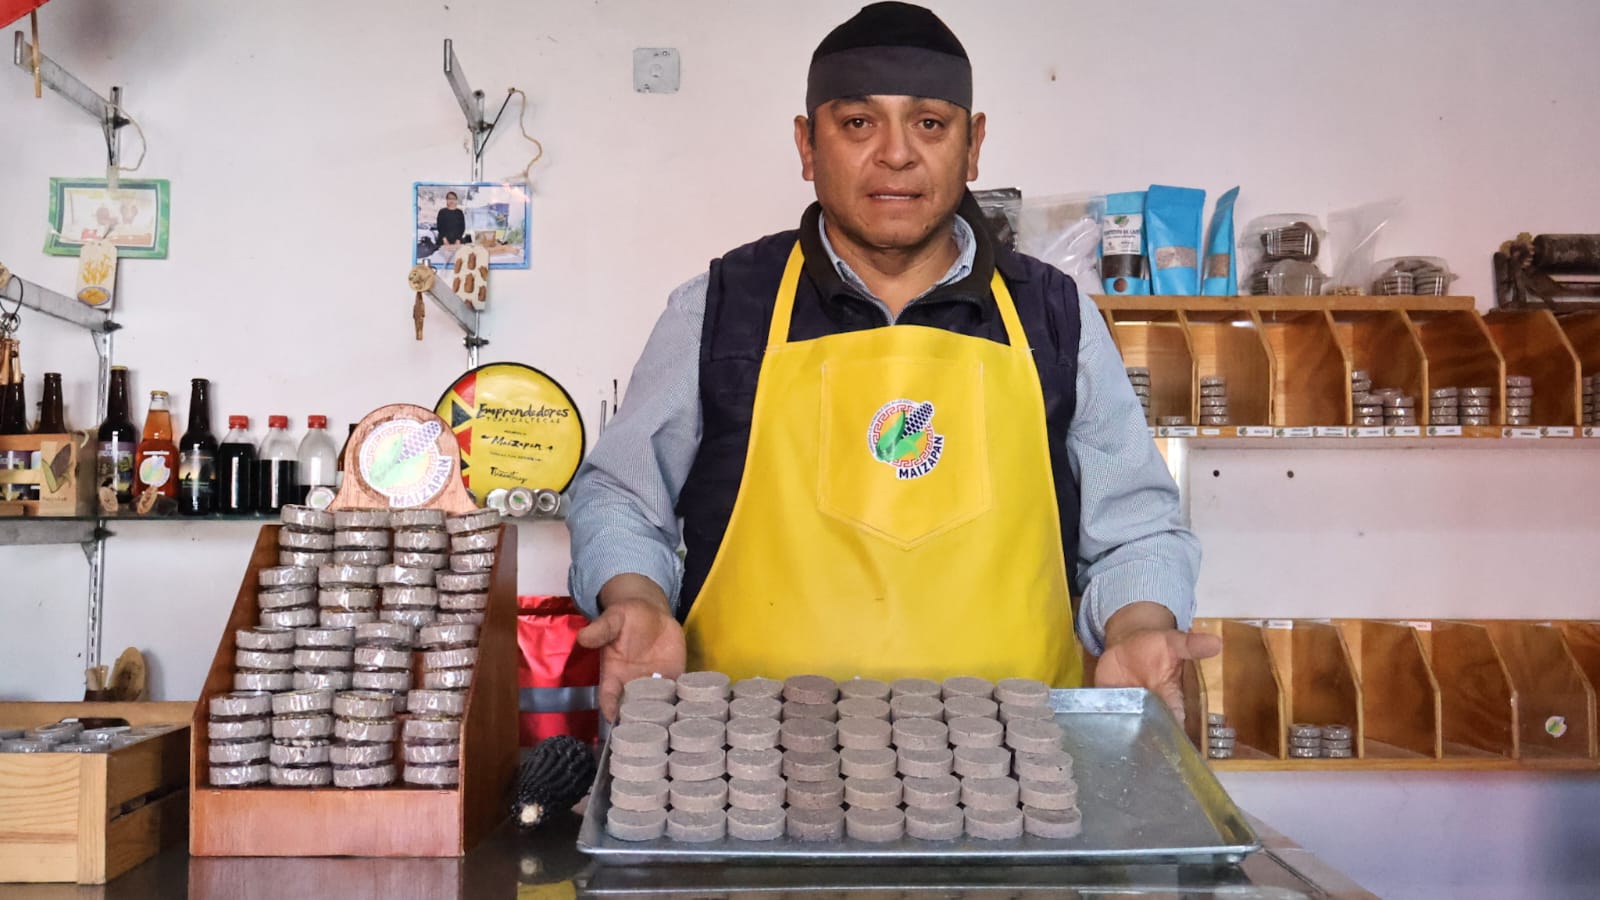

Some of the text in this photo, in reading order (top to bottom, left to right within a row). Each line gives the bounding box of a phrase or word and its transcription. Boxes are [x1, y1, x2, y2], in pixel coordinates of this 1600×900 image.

[476, 403, 569, 419] Emprendedores
[899, 436, 943, 478] MAIZAPAN
[394, 459, 449, 506] MAIZAPAN
